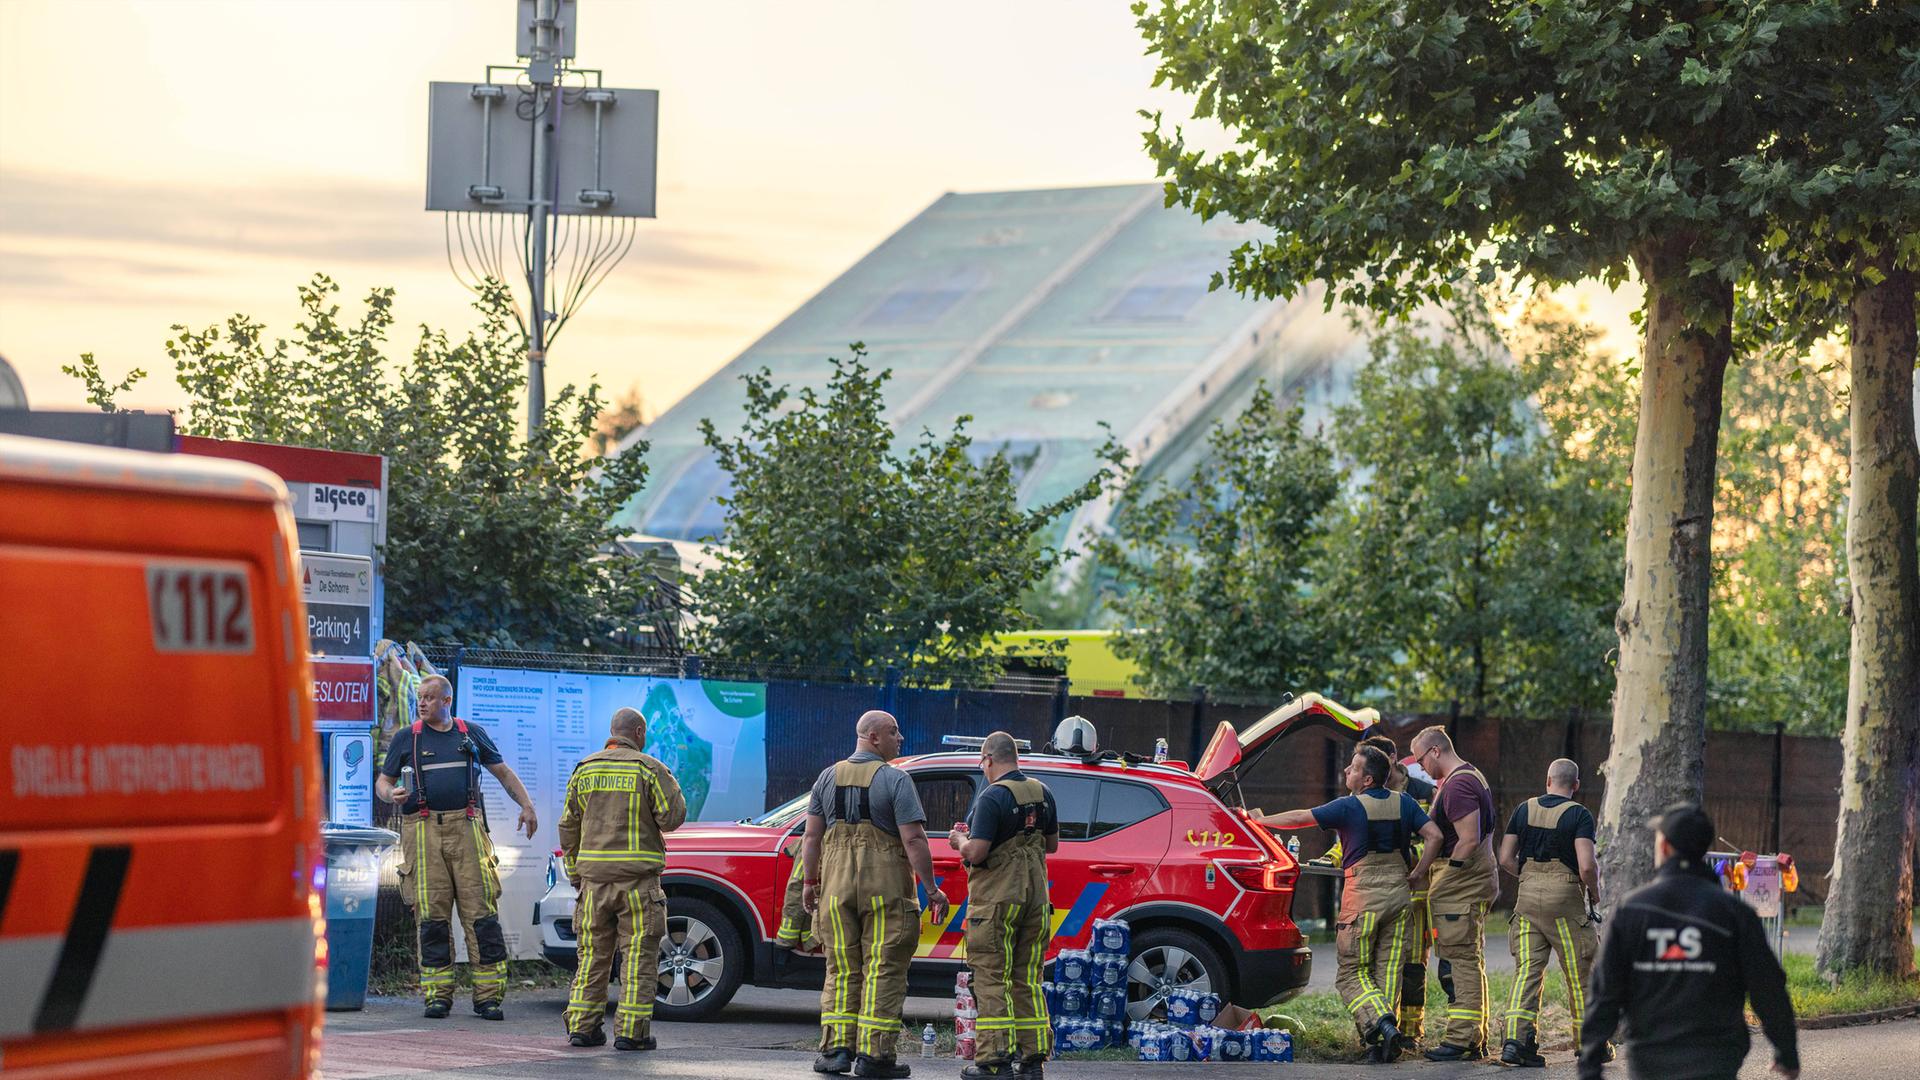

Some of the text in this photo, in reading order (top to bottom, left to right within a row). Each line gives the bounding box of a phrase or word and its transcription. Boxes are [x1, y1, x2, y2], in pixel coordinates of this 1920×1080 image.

[315, 487, 366, 512] algeco
[319, 580, 327, 592] De
[328, 581, 350, 594] Schorre
[175, 572, 247, 645] 112
[308, 615, 361, 645] Parking 4
[311, 680, 369, 703] ESLOTEN
[579, 775, 635, 791] BRNDWEER
[1200, 831, 1235, 848] 112
